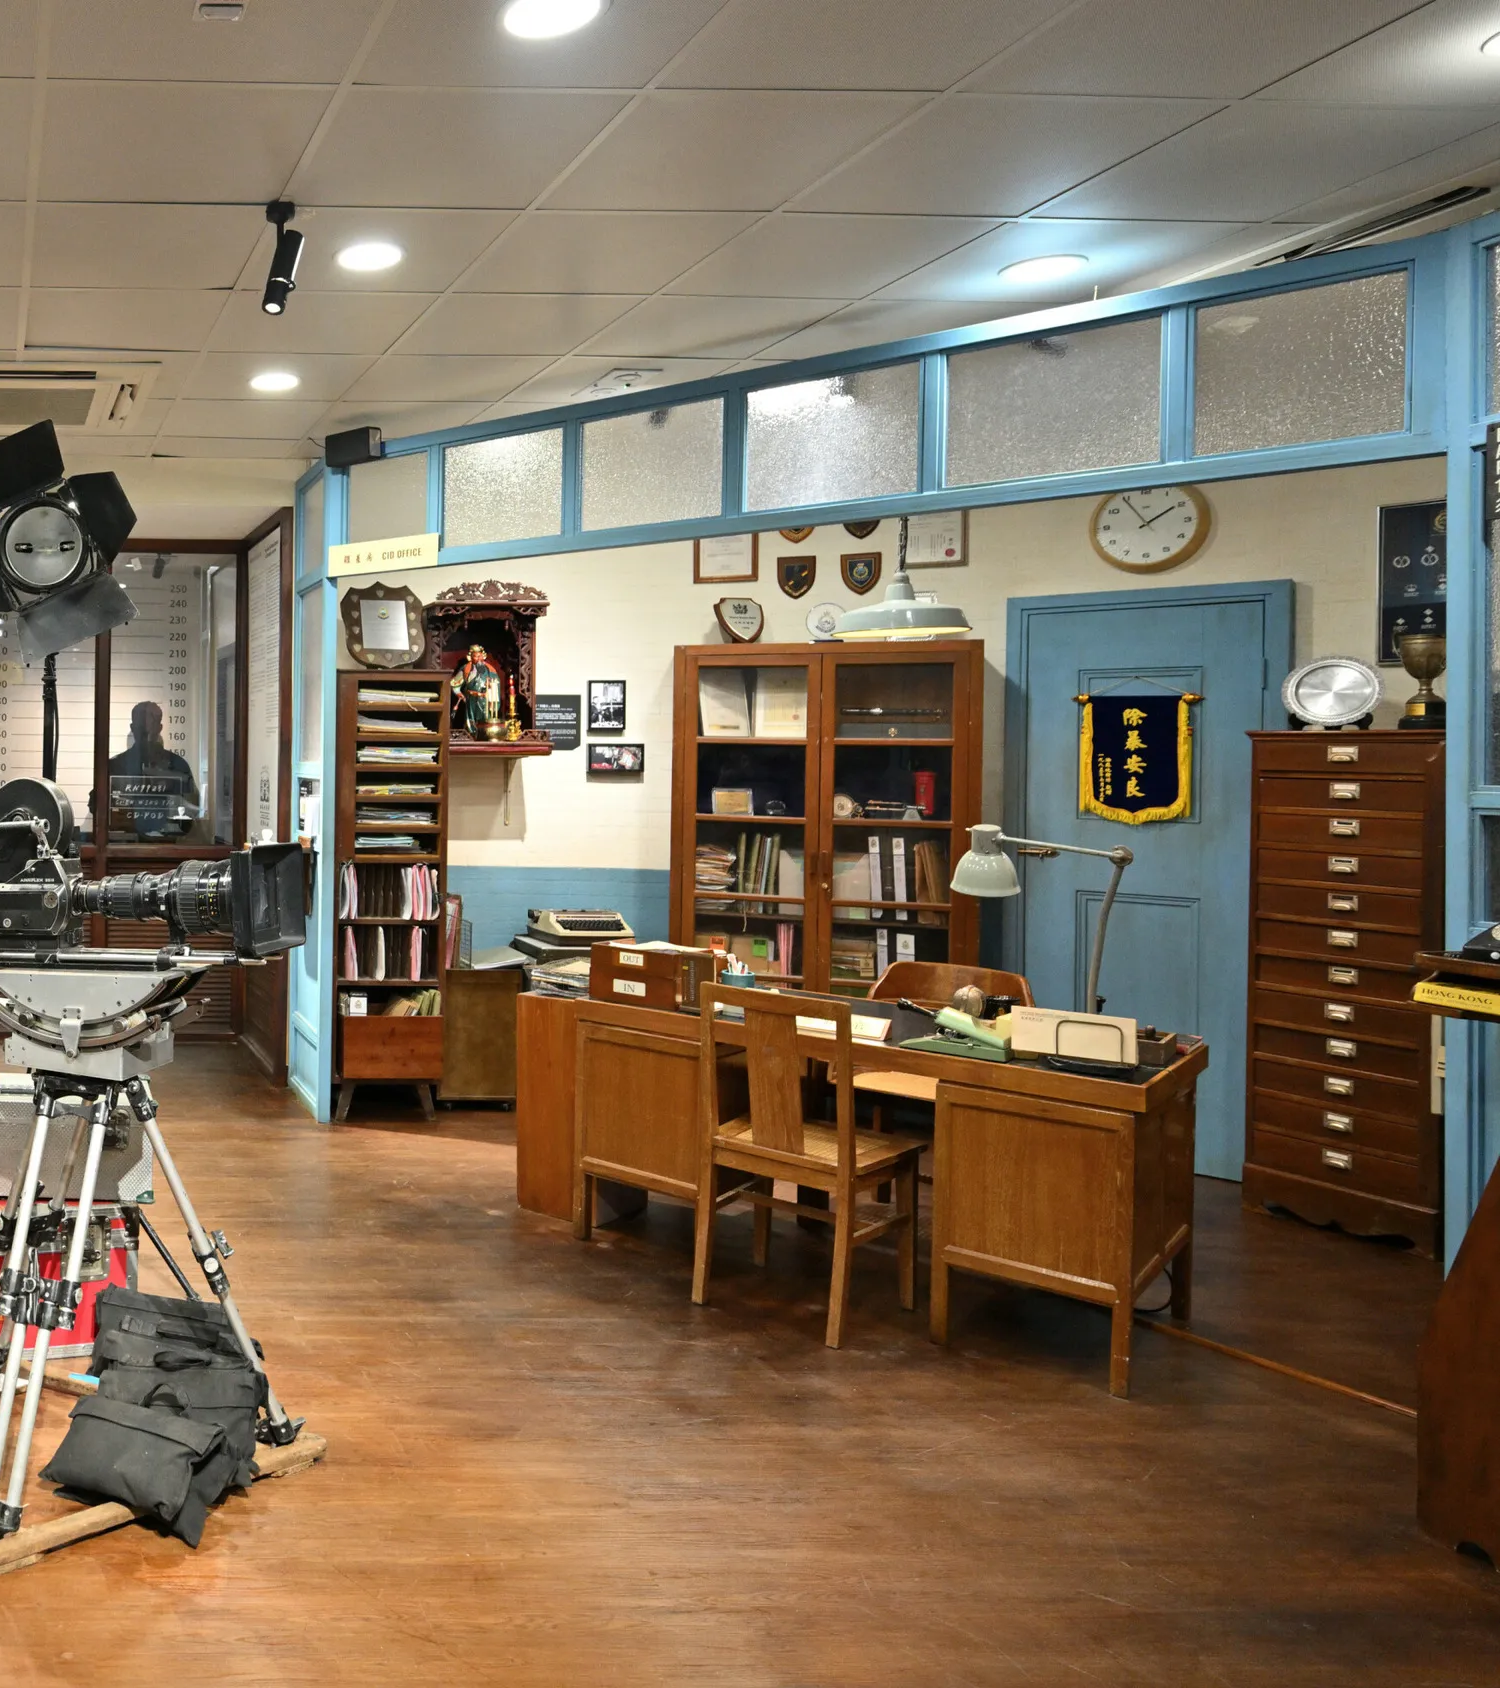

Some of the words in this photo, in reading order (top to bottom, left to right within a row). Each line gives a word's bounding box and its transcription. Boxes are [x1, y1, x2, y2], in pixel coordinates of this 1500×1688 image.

[381, 551, 394, 560] CID
[397, 547, 422, 559] OFFICE
[169, 584, 187, 593] 250
[169, 600, 187, 608] 240
[169, 615, 187, 625] 230
[169, 633, 187, 642] 220
[169, 649, 187, 658] 210
[168, 666, 187, 675] 200
[169, 683, 186, 692] 190
[169, 699, 186, 708] 180
[169, 715, 186, 724] 170
[169, 732, 186, 741] 160
[1123, 708, 1148, 798] 除暴安良
[623, 954, 641, 964] OUT
[623, 983, 636, 993] IN
[1422, 988, 1455, 999] HONG
[1458, 994, 1493, 1005] KONG
